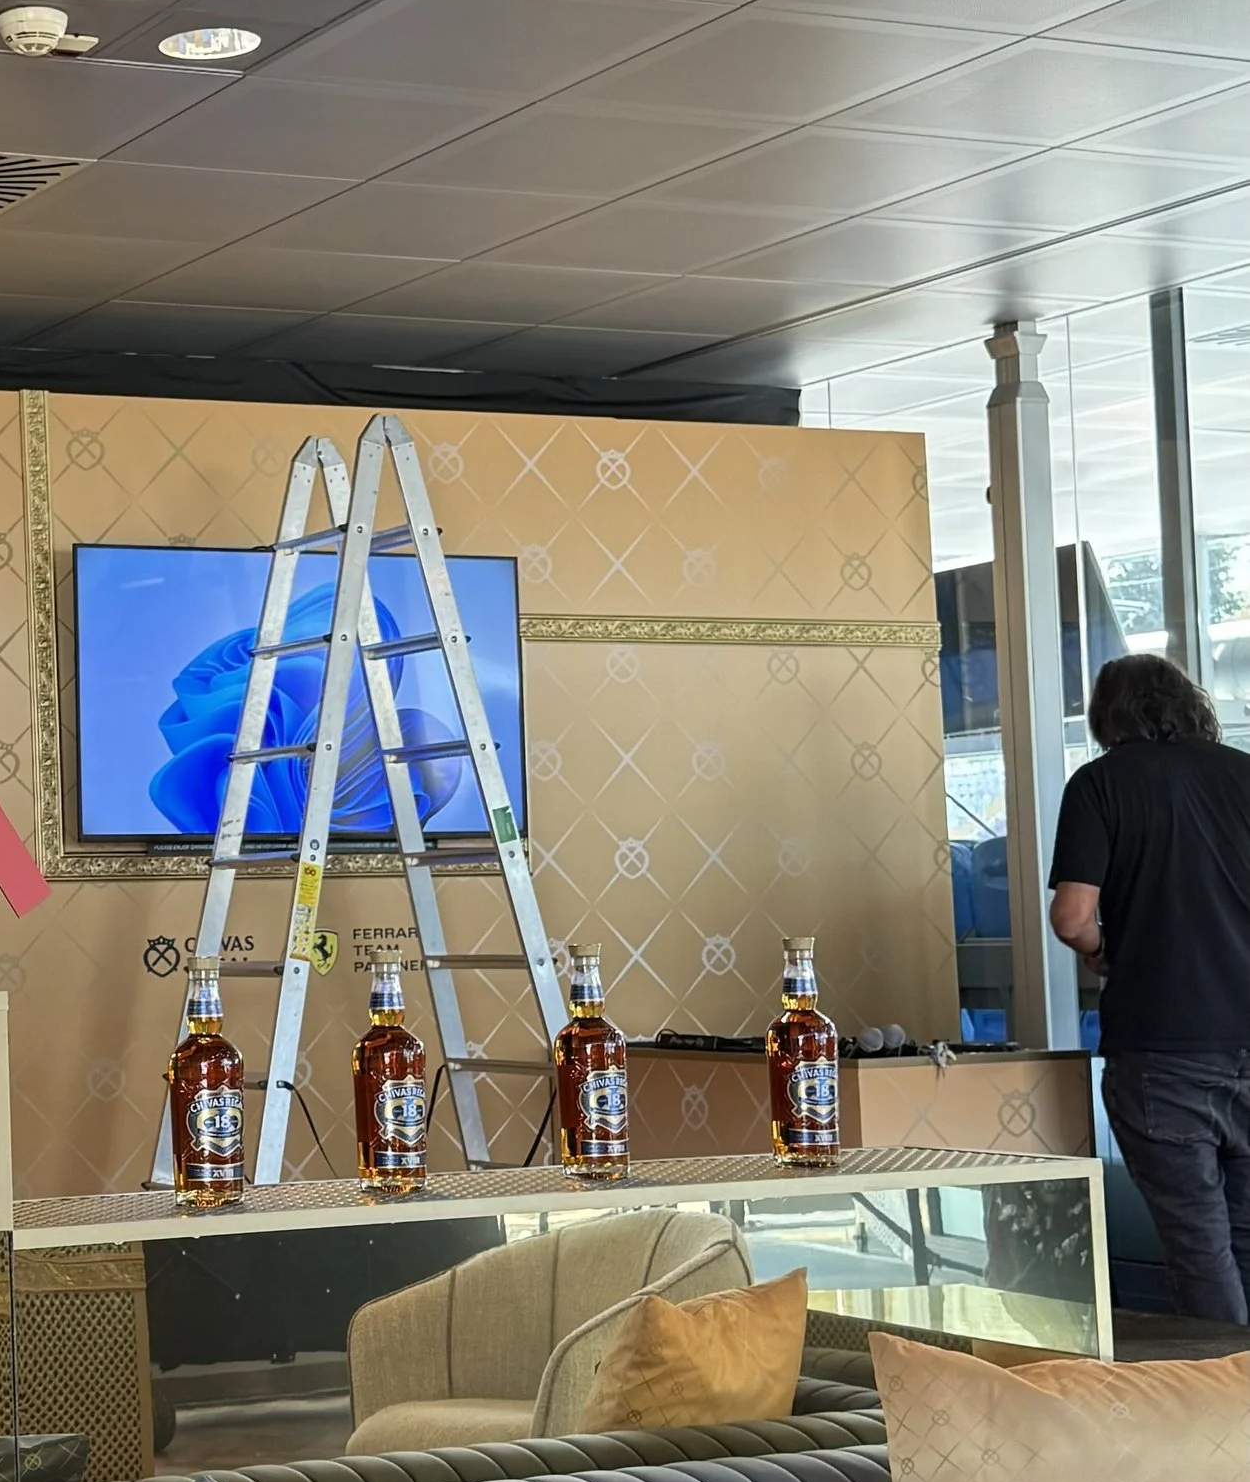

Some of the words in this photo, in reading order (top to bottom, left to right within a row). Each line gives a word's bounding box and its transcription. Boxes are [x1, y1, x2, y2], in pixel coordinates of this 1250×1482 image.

[353, 927, 418, 940] FERRAR
[184, 935, 254, 953] CVAS
[354, 960, 424, 973] PANE
[791, 1068, 824, 1082] CHIVAS
[583, 1076, 615, 1092] CHIVAS
[378, 1087, 411, 1102] CHIVAS
[606, 1093, 621, 1107] 18
[190, 1097, 224, 1113] CHIVAS
[402, 1103, 417, 1117] 18
[214, 1114, 231, 1128] 18
